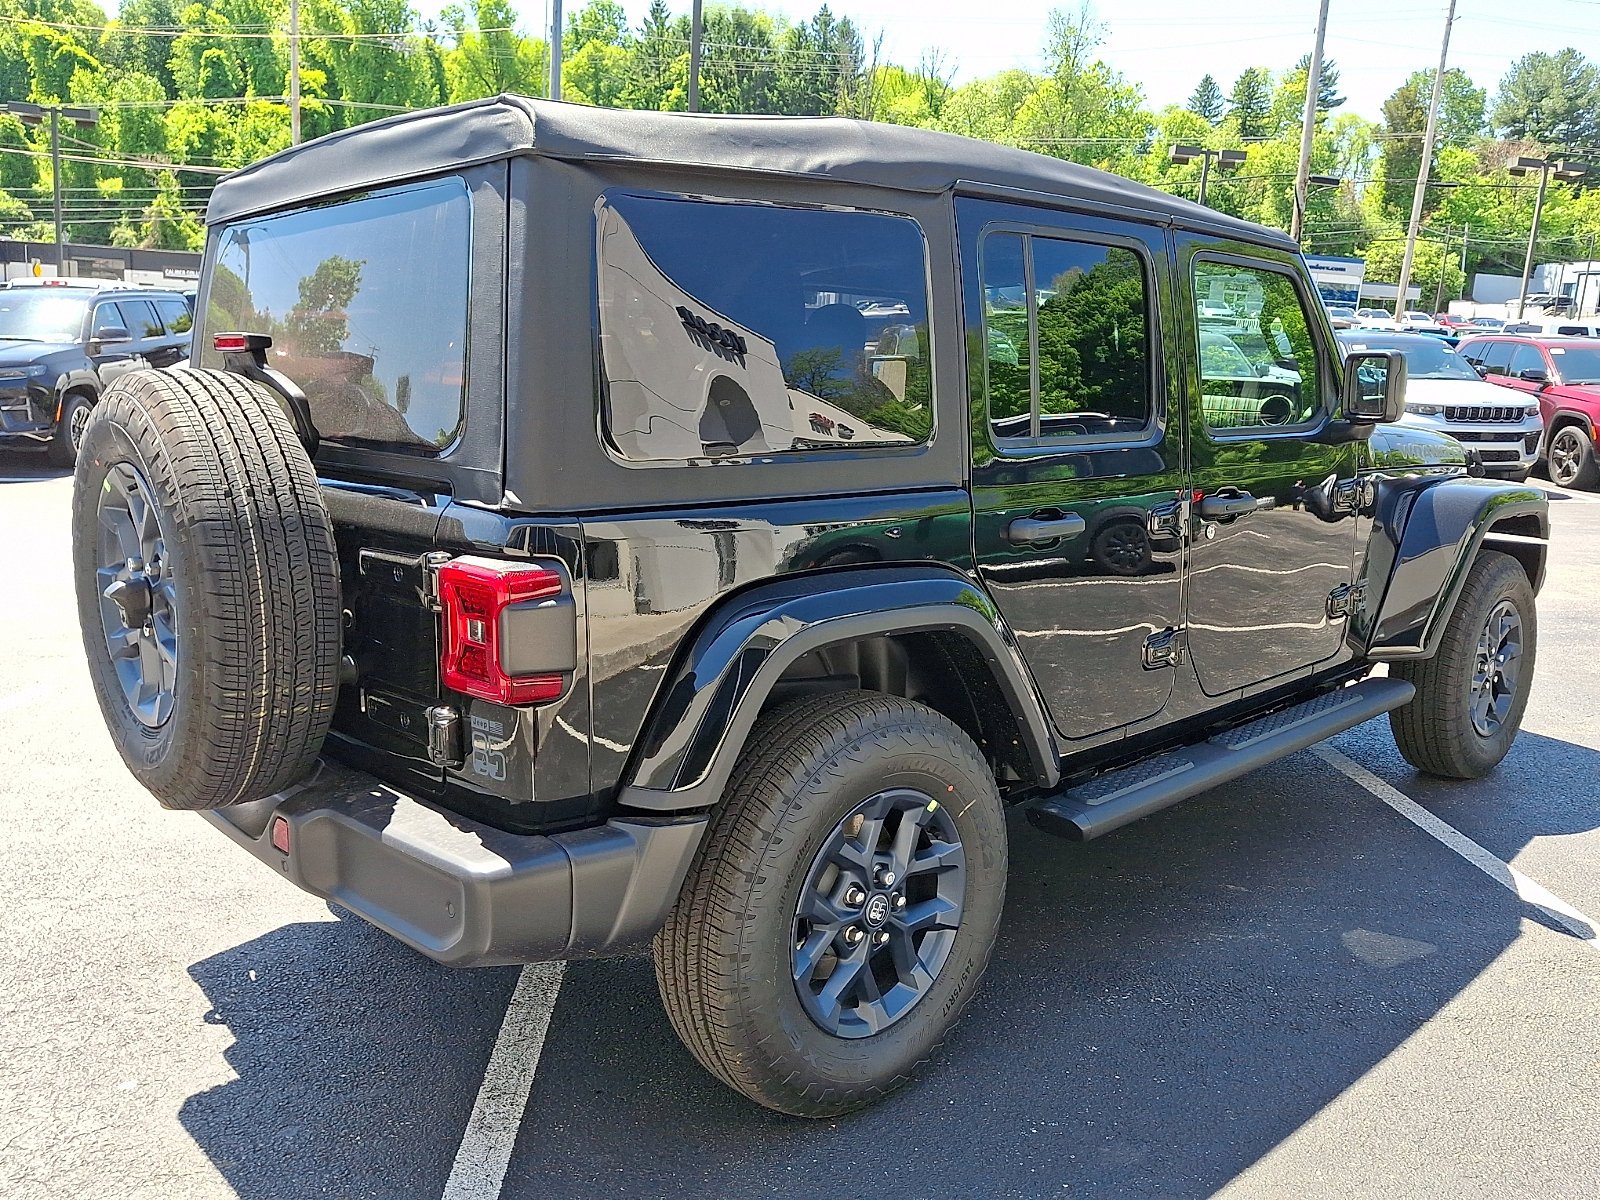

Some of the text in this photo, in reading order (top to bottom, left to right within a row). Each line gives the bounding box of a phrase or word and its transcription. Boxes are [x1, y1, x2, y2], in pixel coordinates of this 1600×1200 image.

[472, 718, 488, 730] Jeep
[777, 832, 812, 915] All-Weather
[942, 957, 975, 1018] 245/75R17
